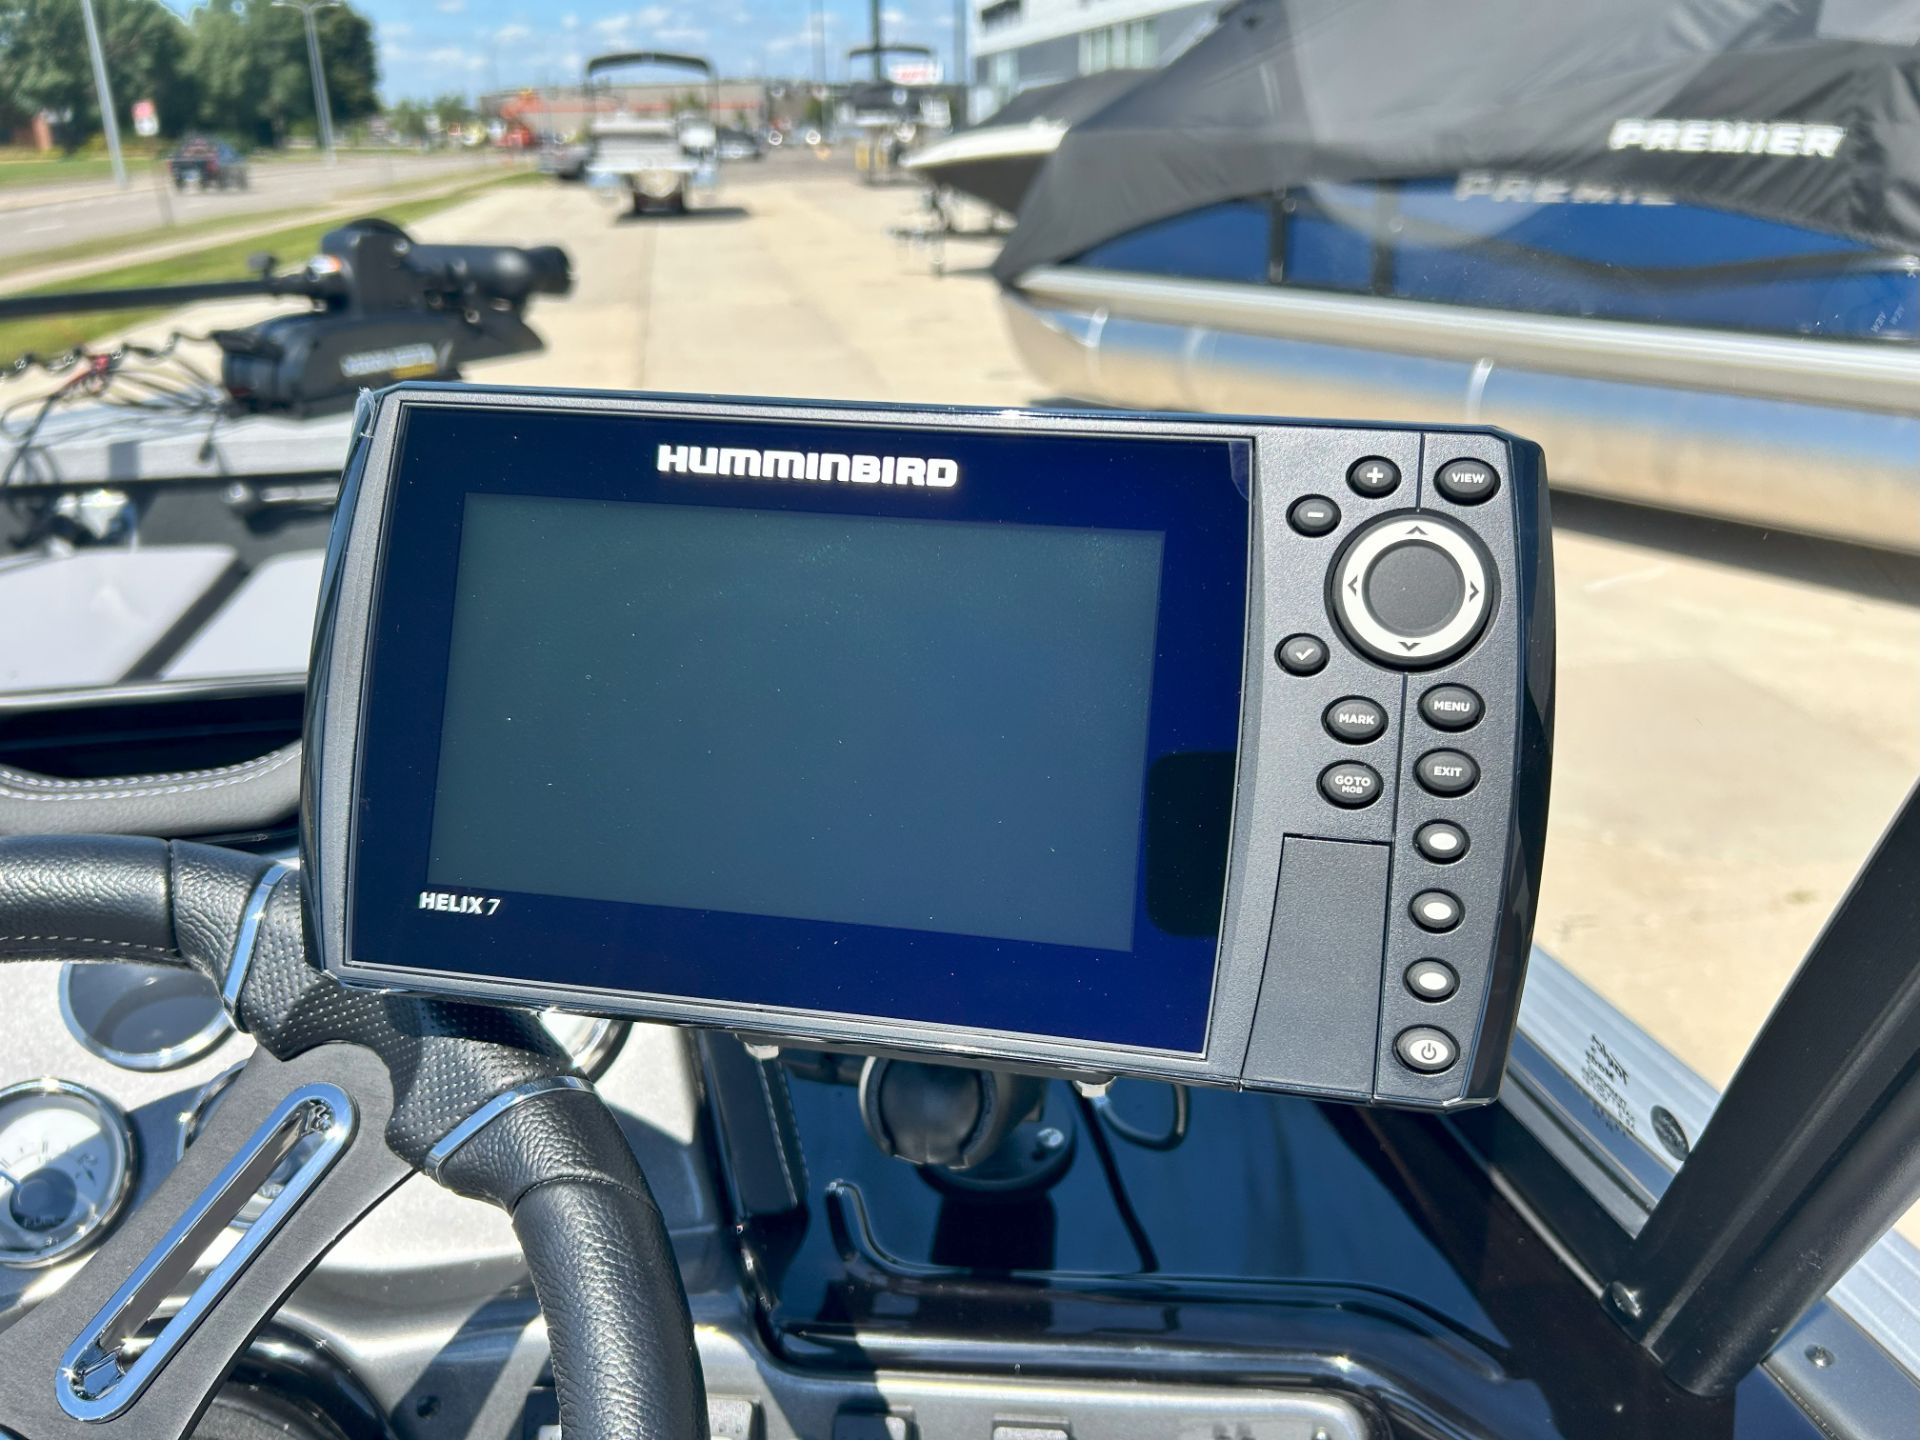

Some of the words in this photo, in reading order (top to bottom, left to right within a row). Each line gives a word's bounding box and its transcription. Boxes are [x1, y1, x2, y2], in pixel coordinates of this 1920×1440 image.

[1608, 117, 1846, 158] PREMIER
[656, 444, 959, 488] HUMMINBIRD
[1451, 472, 1486, 484] VIEW
[1433, 700, 1471, 712] MENU
[1338, 713, 1375, 725] MARK
[1433, 765, 1463, 777] EXIT
[1341, 785, 1363, 794] MOB
[418, 891, 484, 915] HELIX
[487, 898, 501, 916] 7
